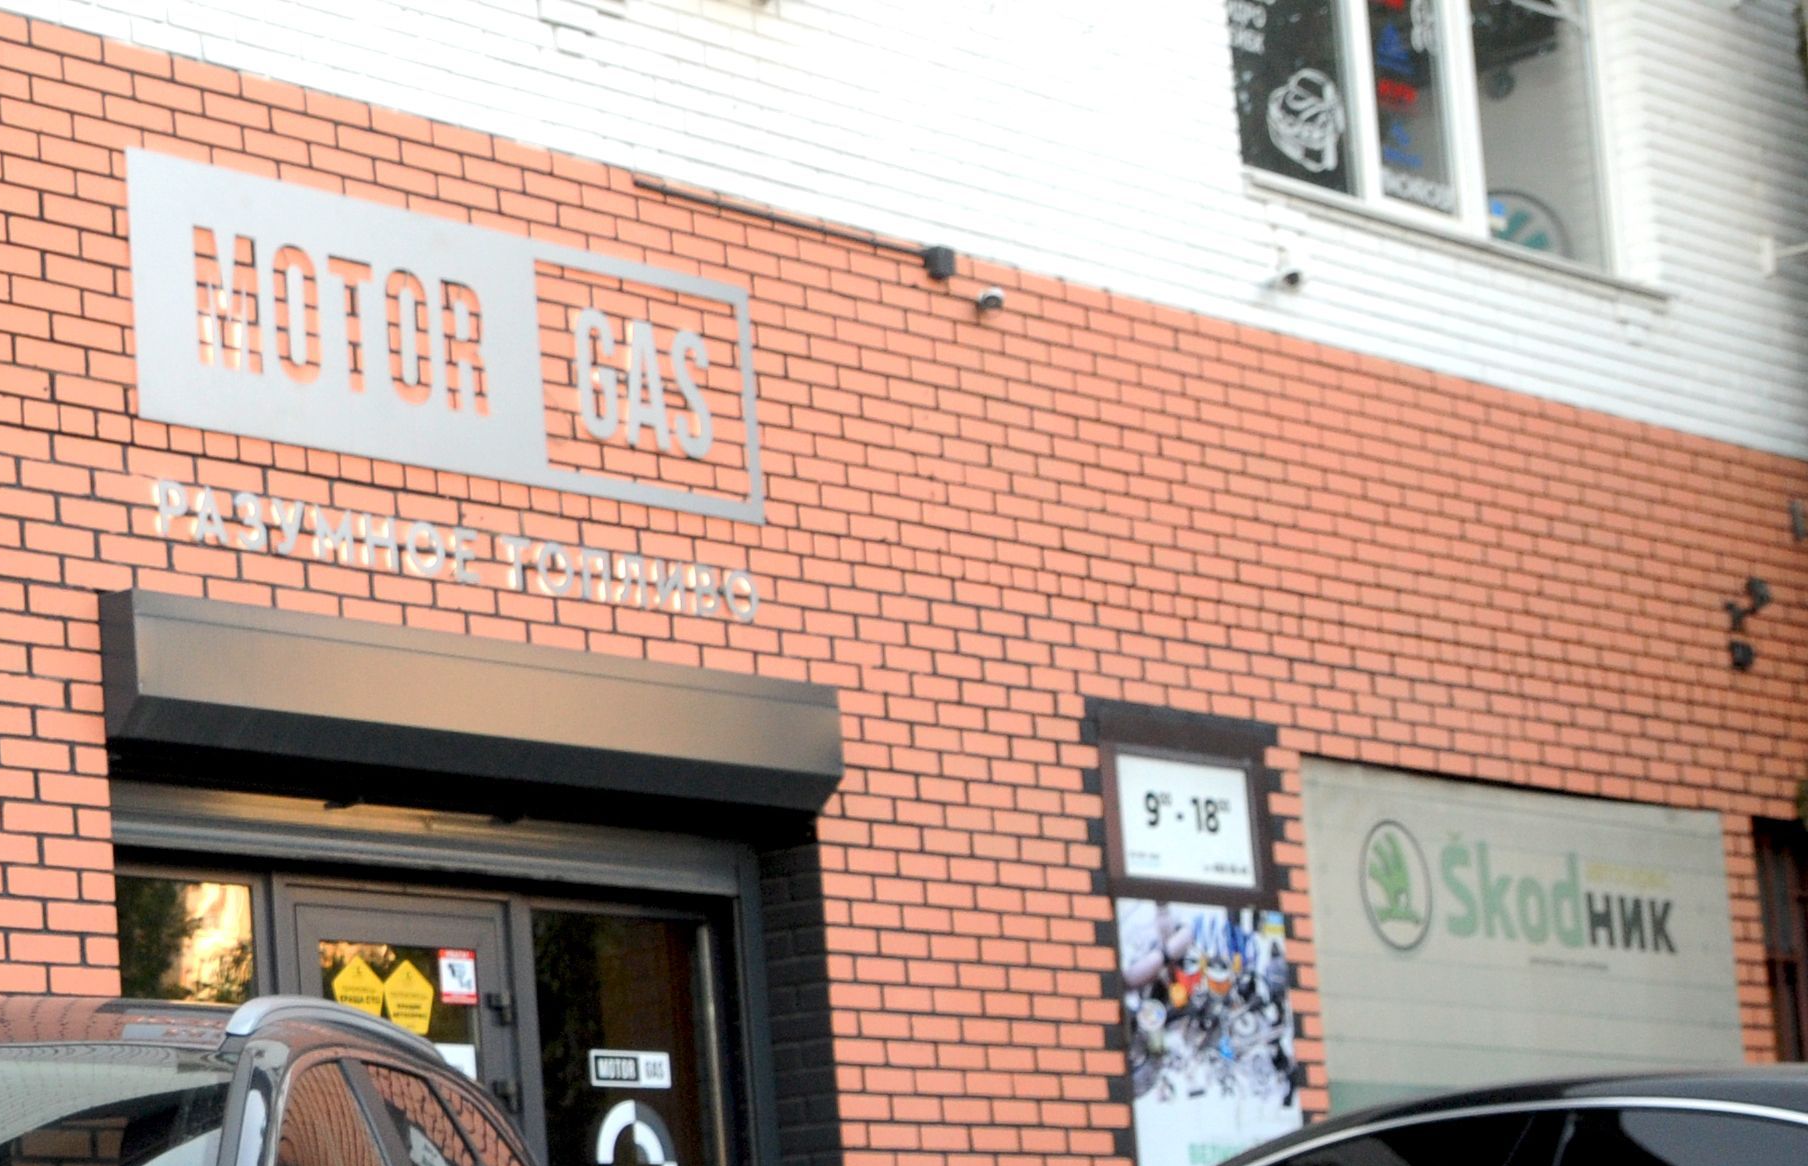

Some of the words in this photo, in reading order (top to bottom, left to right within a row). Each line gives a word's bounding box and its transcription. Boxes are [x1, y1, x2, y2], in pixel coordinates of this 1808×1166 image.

[191, 225, 491, 417] MOTOR
[573, 306, 713, 460] GAS
[154, 479, 480, 585] РАЗУМНОЕ
[498, 534, 759, 624] ТОПЛИВО
[597, 1057, 637, 1080] MOTOR
